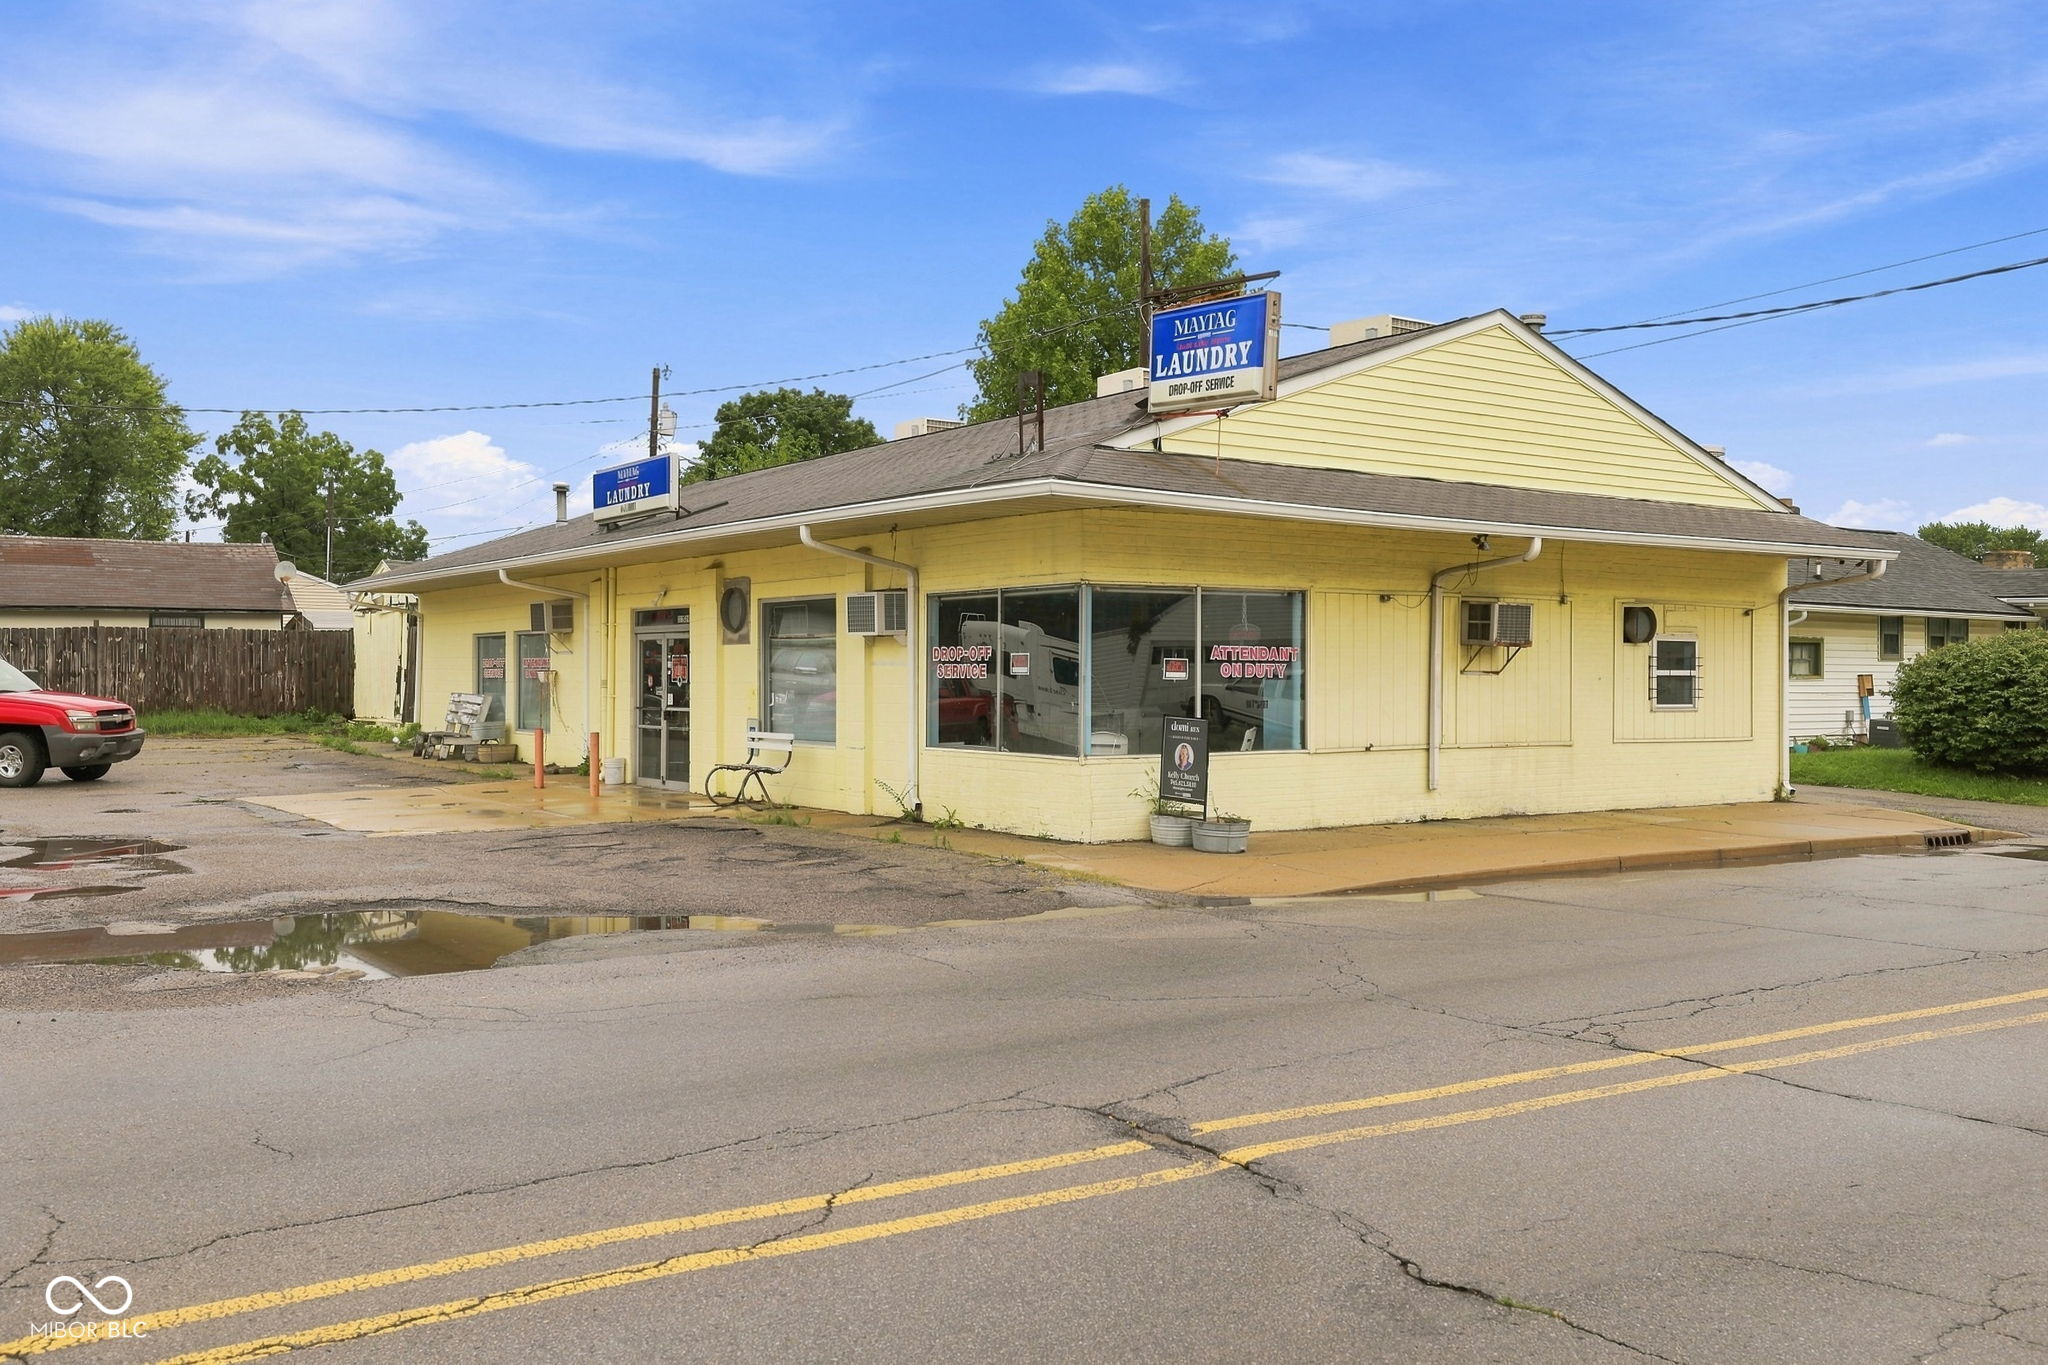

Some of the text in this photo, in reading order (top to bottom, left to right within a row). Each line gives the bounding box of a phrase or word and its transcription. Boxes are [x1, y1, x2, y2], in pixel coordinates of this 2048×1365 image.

[1174, 309, 1236, 336] MAYTAG
[1156, 340, 1252, 377] LAUNDRY
[1168, 375, 1235, 397] DROP-OFF SERVICE
[606, 482, 650, 504] LAUNDRY
[932, 646, 992, 661] DROP-OFF
[1210, 645, 1299, 662] ATTENDANT
[937, 664, 987, 679] SERVICE
[1220, 662, 1287, 678] ON DUTY
